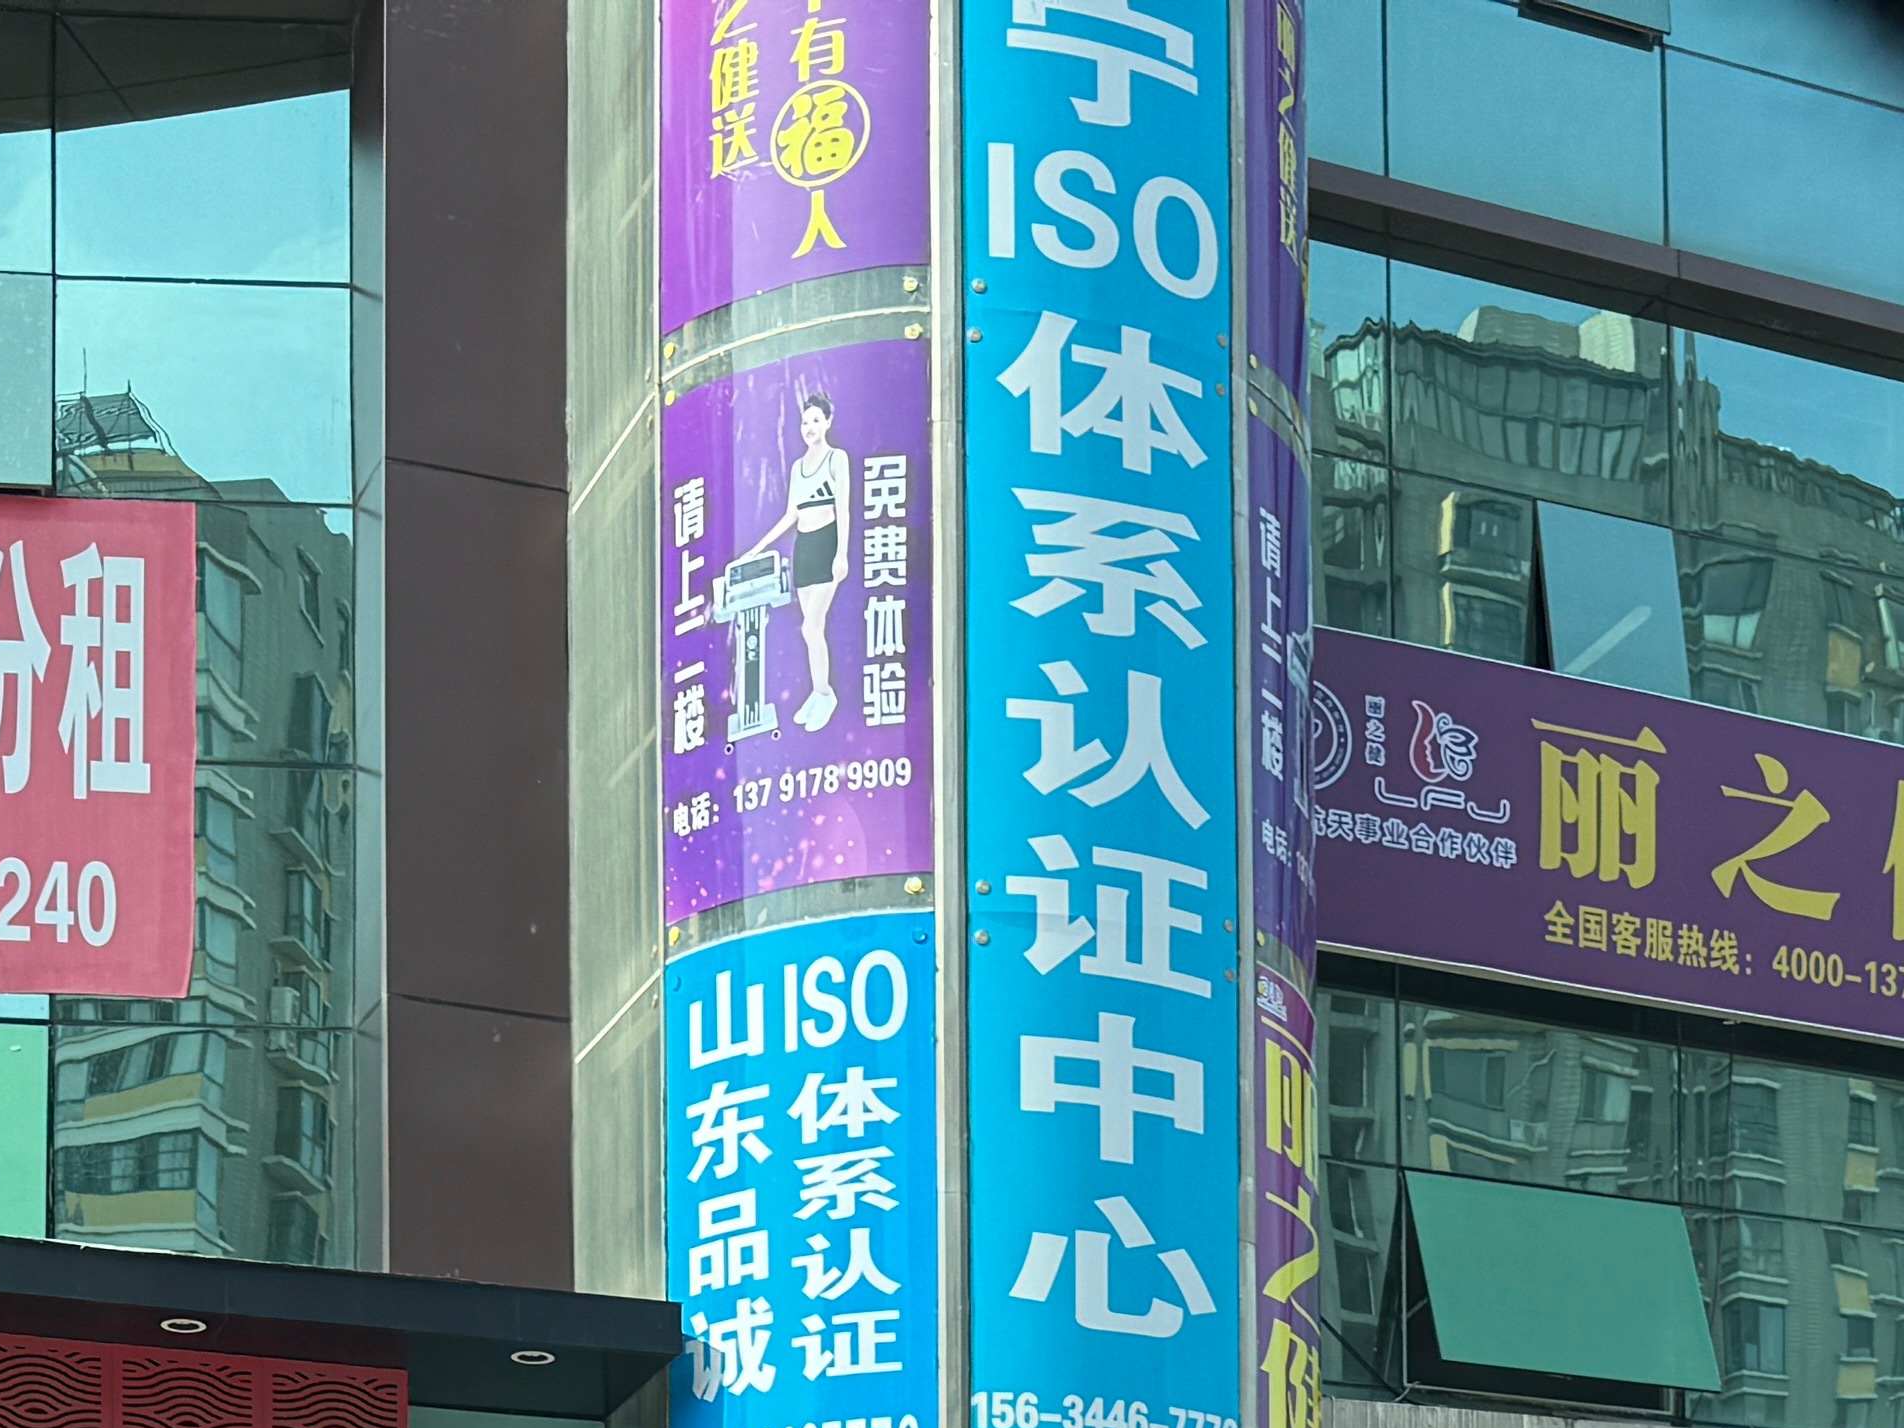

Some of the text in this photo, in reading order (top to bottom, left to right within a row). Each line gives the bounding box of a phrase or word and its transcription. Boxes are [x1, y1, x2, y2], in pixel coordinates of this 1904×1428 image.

[770, 0, 871, 258] 有福人
[672, 477, 706, 756] 请上二楼
[862, 454, 909, 728] 免费体验
[733, 777, 772, 813] 137
[779, 764, 839, 803] 9178
[846, 757, 912, 791] 9909
[685, 971, 778, 1404] 山东品诚
[782, 948, 909, 1380] ISO体系认证
